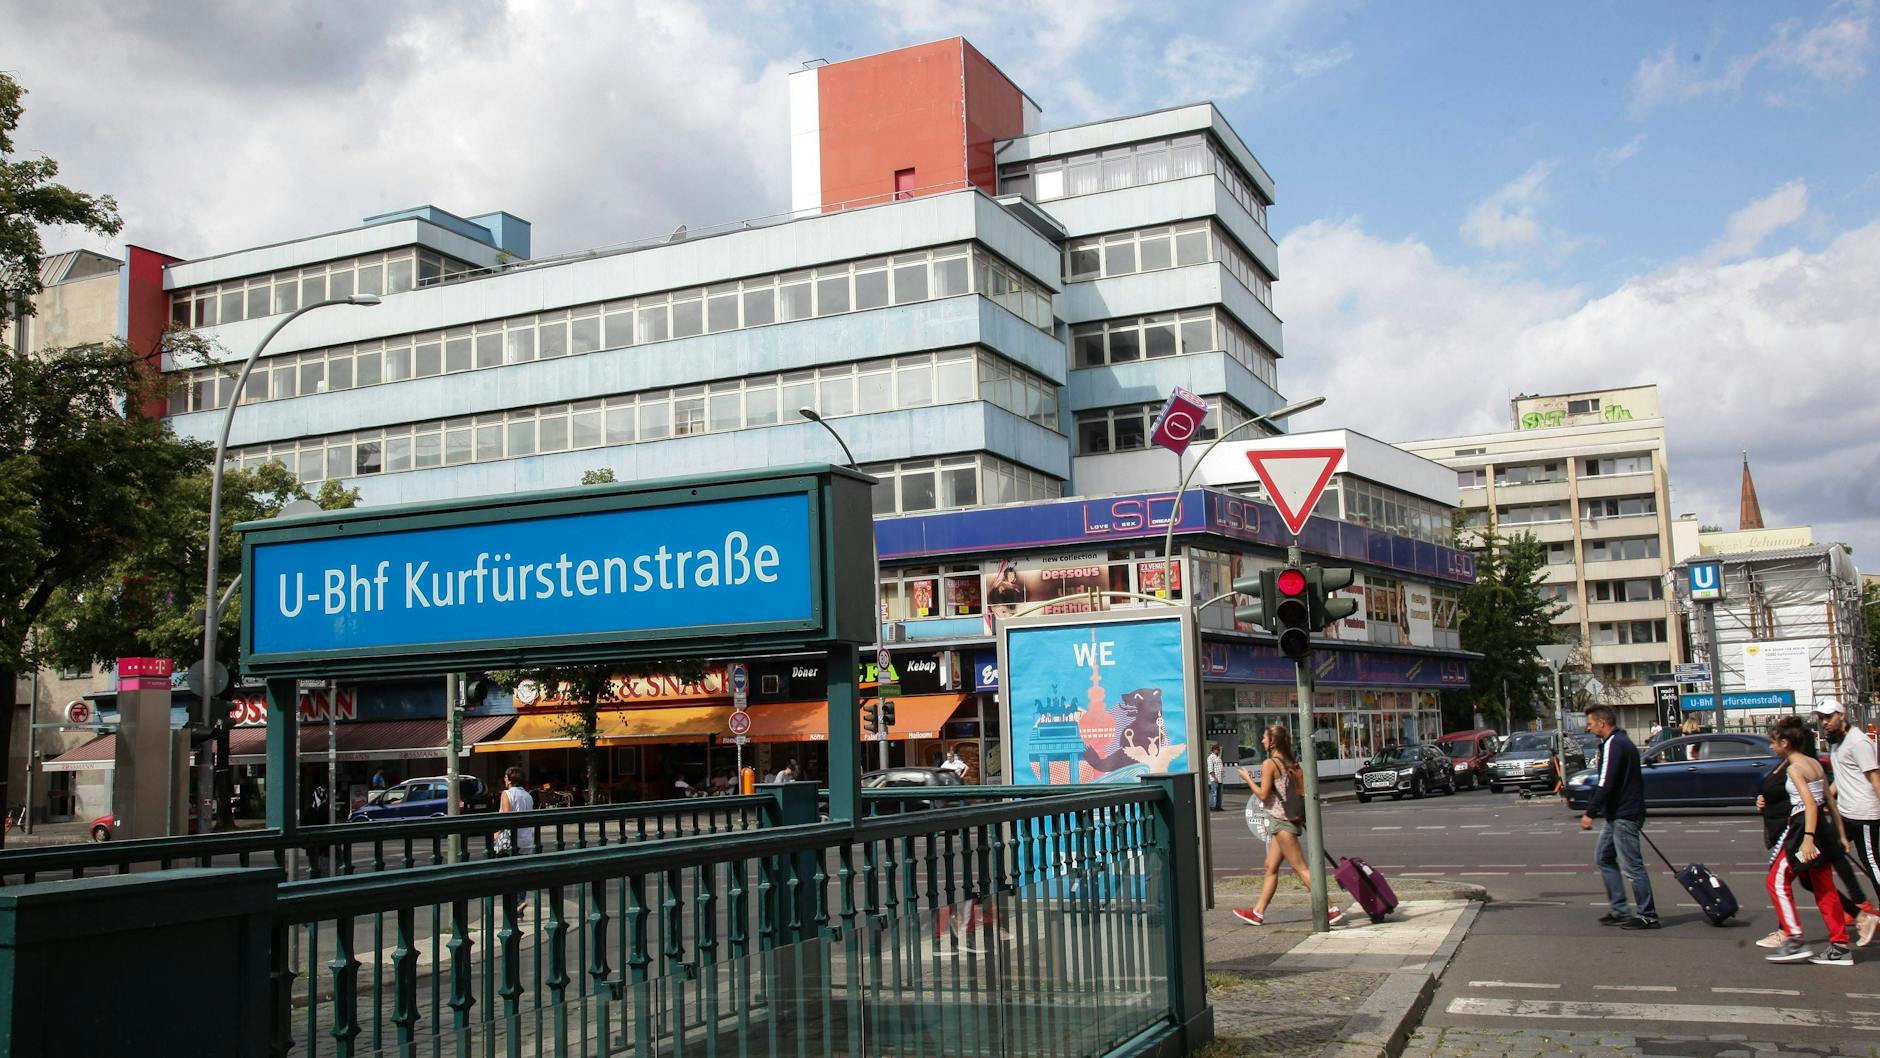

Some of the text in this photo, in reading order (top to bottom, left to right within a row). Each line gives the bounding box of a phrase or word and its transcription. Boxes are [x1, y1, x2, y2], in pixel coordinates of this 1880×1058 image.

[1084, 495, 1183, 534] LSD
[279, 530, 780, 618] U-Bhf Kurfürstenstraße
[1041, 566, 1100, 581] Dessous
[1692, 566, 1714, 589] U
[1073, 641, 1116, 667] WE
[791, 666, 819, 678] Döner
[907, 660, 937, 673] Kebap
[618, 674, 641, 699] &
[1690, 697, 1713, 708] U-Bhf
